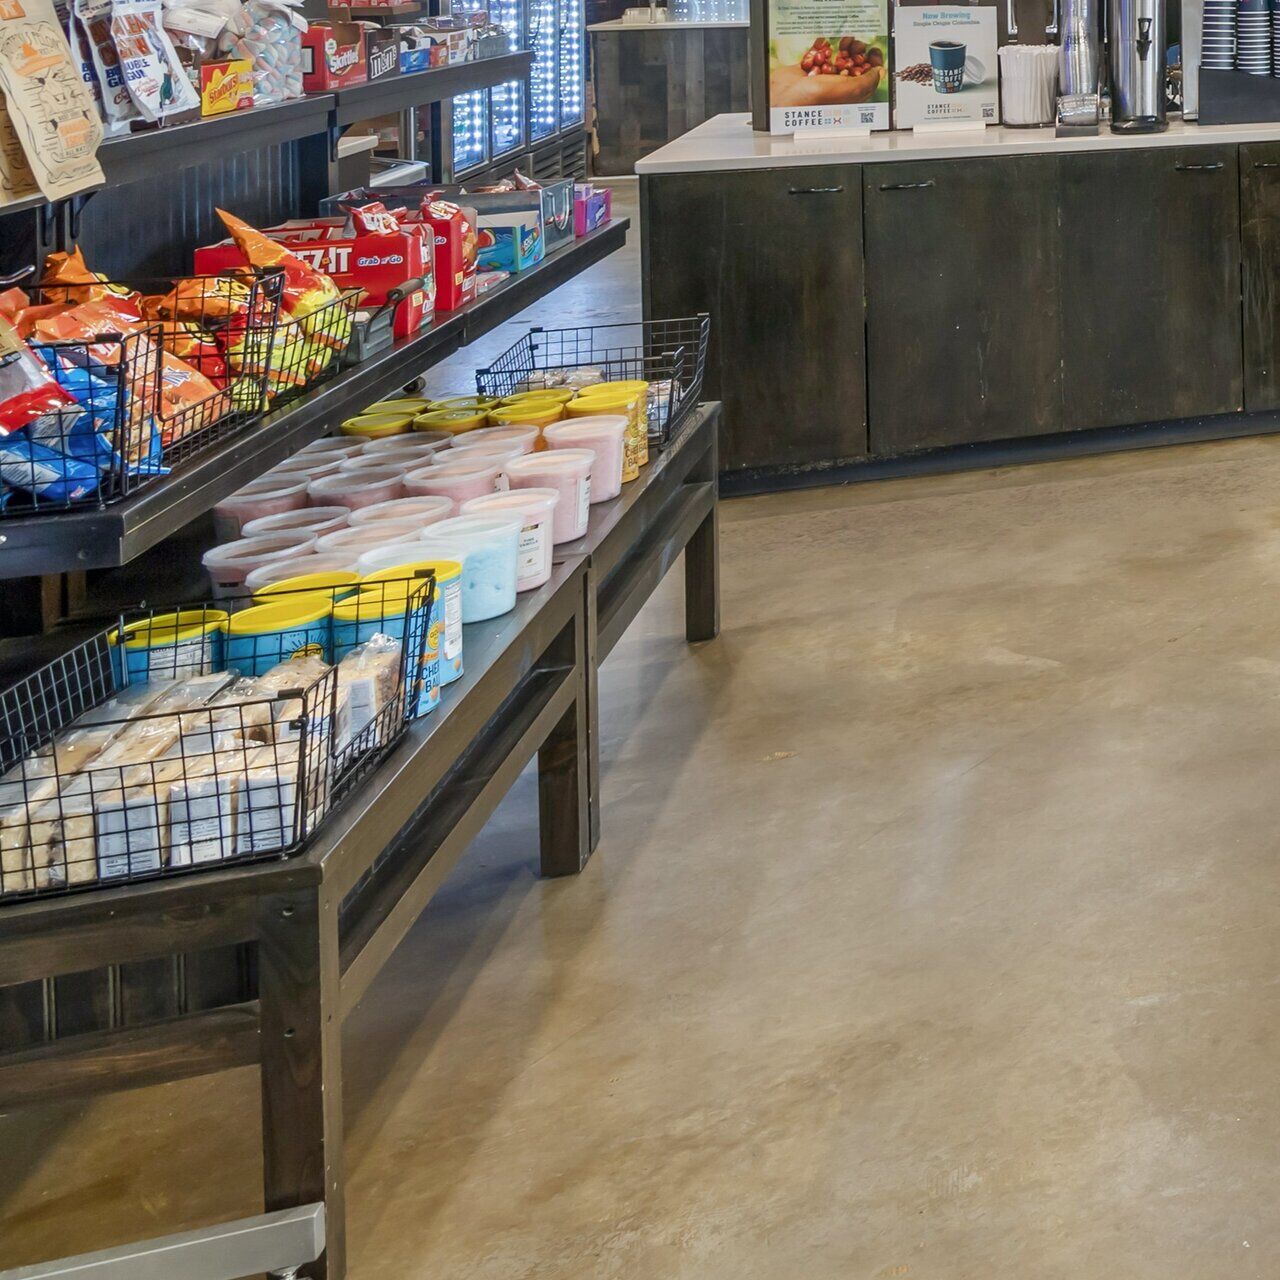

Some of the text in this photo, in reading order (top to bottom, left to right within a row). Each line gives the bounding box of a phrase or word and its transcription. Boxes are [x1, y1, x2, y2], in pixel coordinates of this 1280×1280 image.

[785, 110, 822, 118] STANCE
[785, 118, 822, 127] COFFEE
[358, 256, 380, 267] Grab
[390, 255, 404, 265] Go
